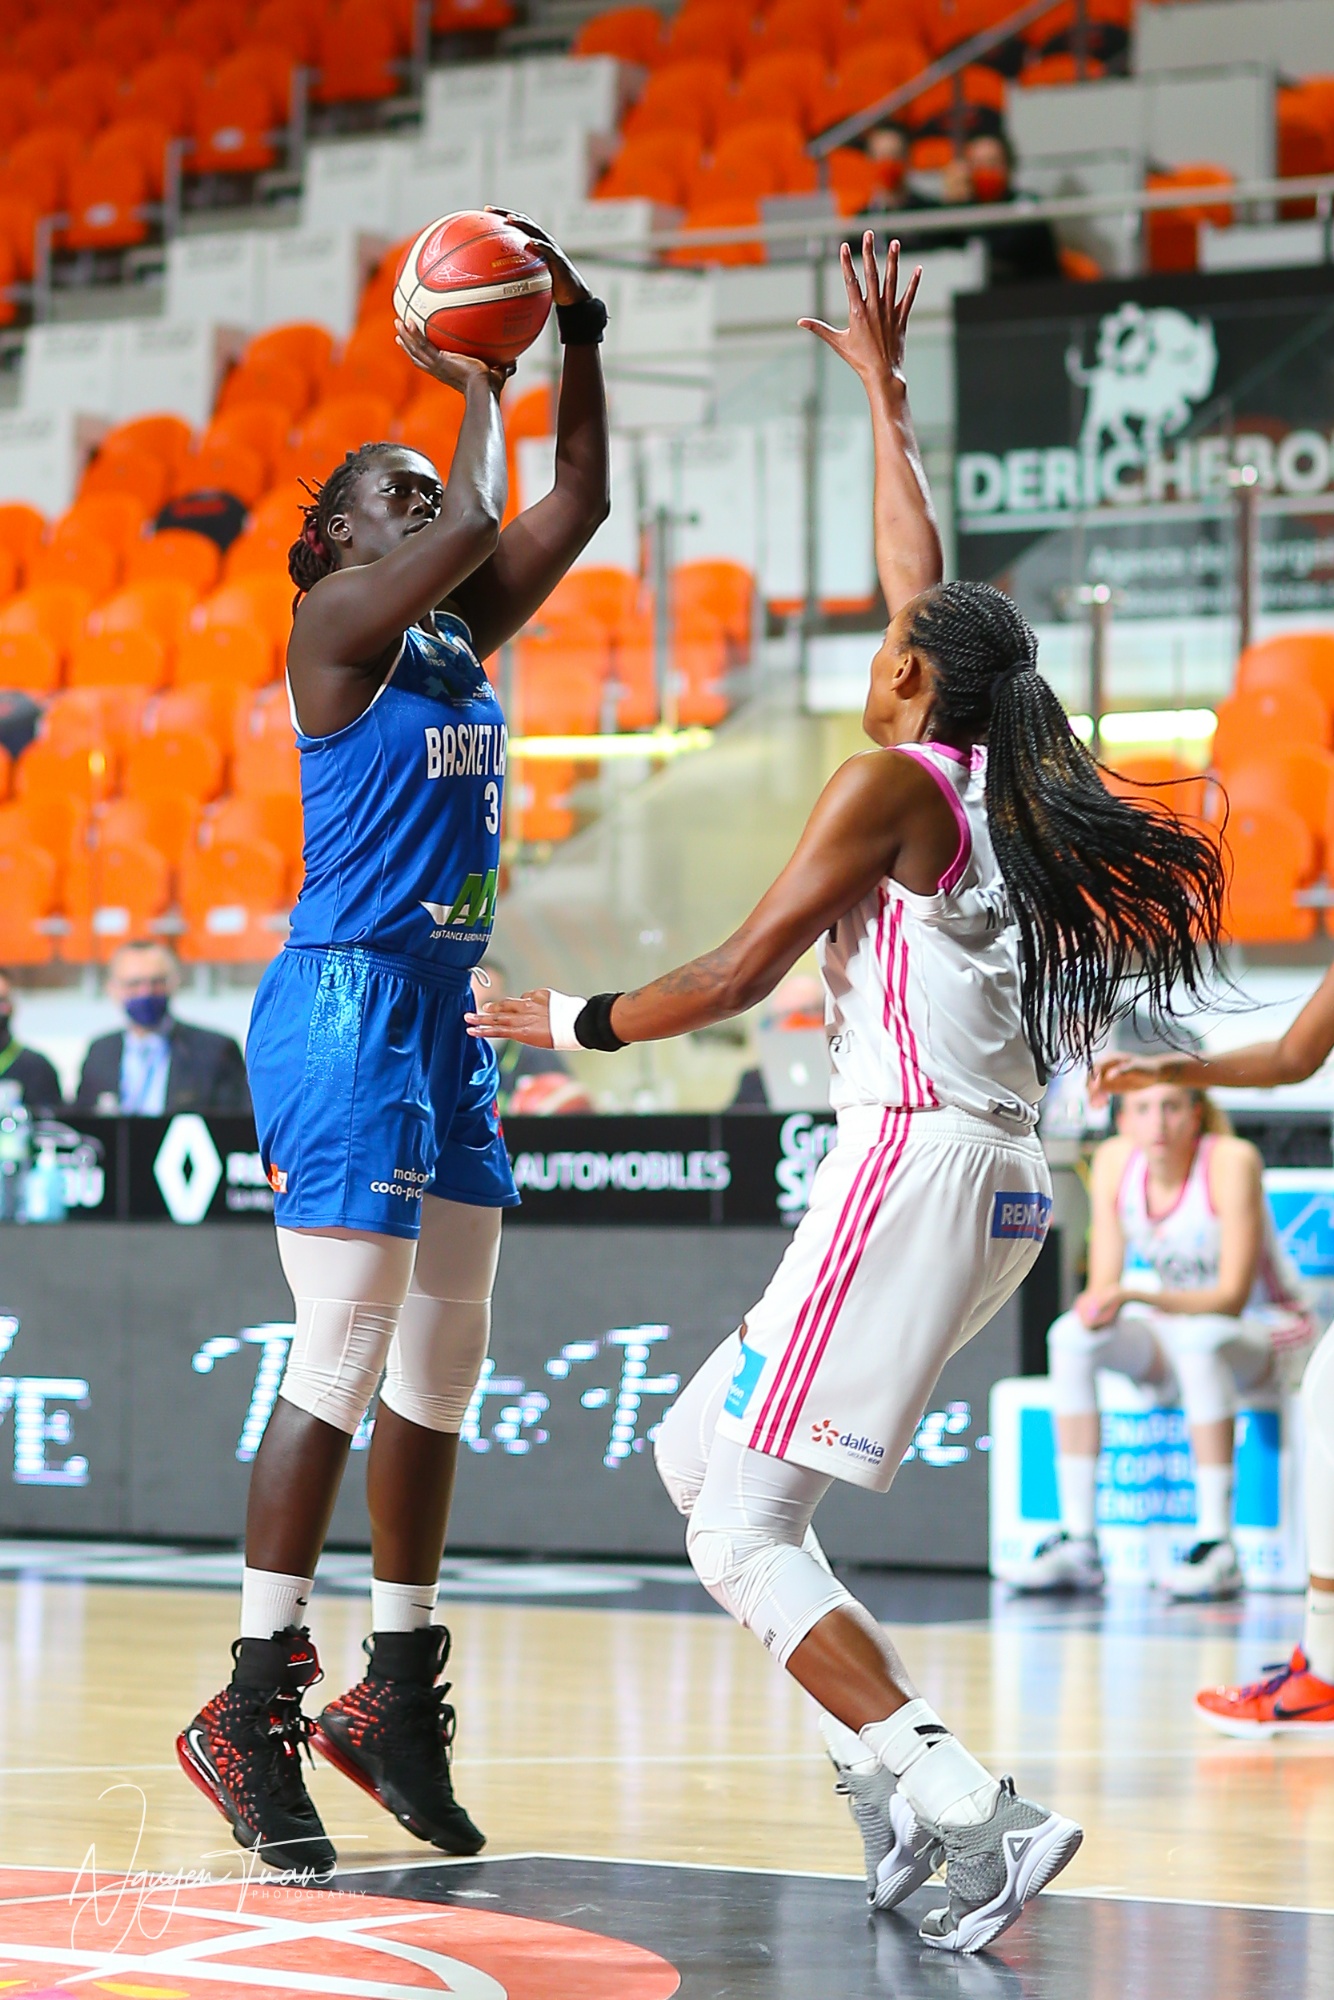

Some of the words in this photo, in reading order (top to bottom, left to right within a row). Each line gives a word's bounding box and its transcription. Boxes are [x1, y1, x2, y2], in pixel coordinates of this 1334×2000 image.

[956, 430, 1334, 512] DERICHEBO
[424, 723, 492, 780] BASKET
[484, 781, 499, 835] 3
[513, 1151, 732, 1192] AUTOMOBILES
[839, 1432, 885, 1458] dalkia
